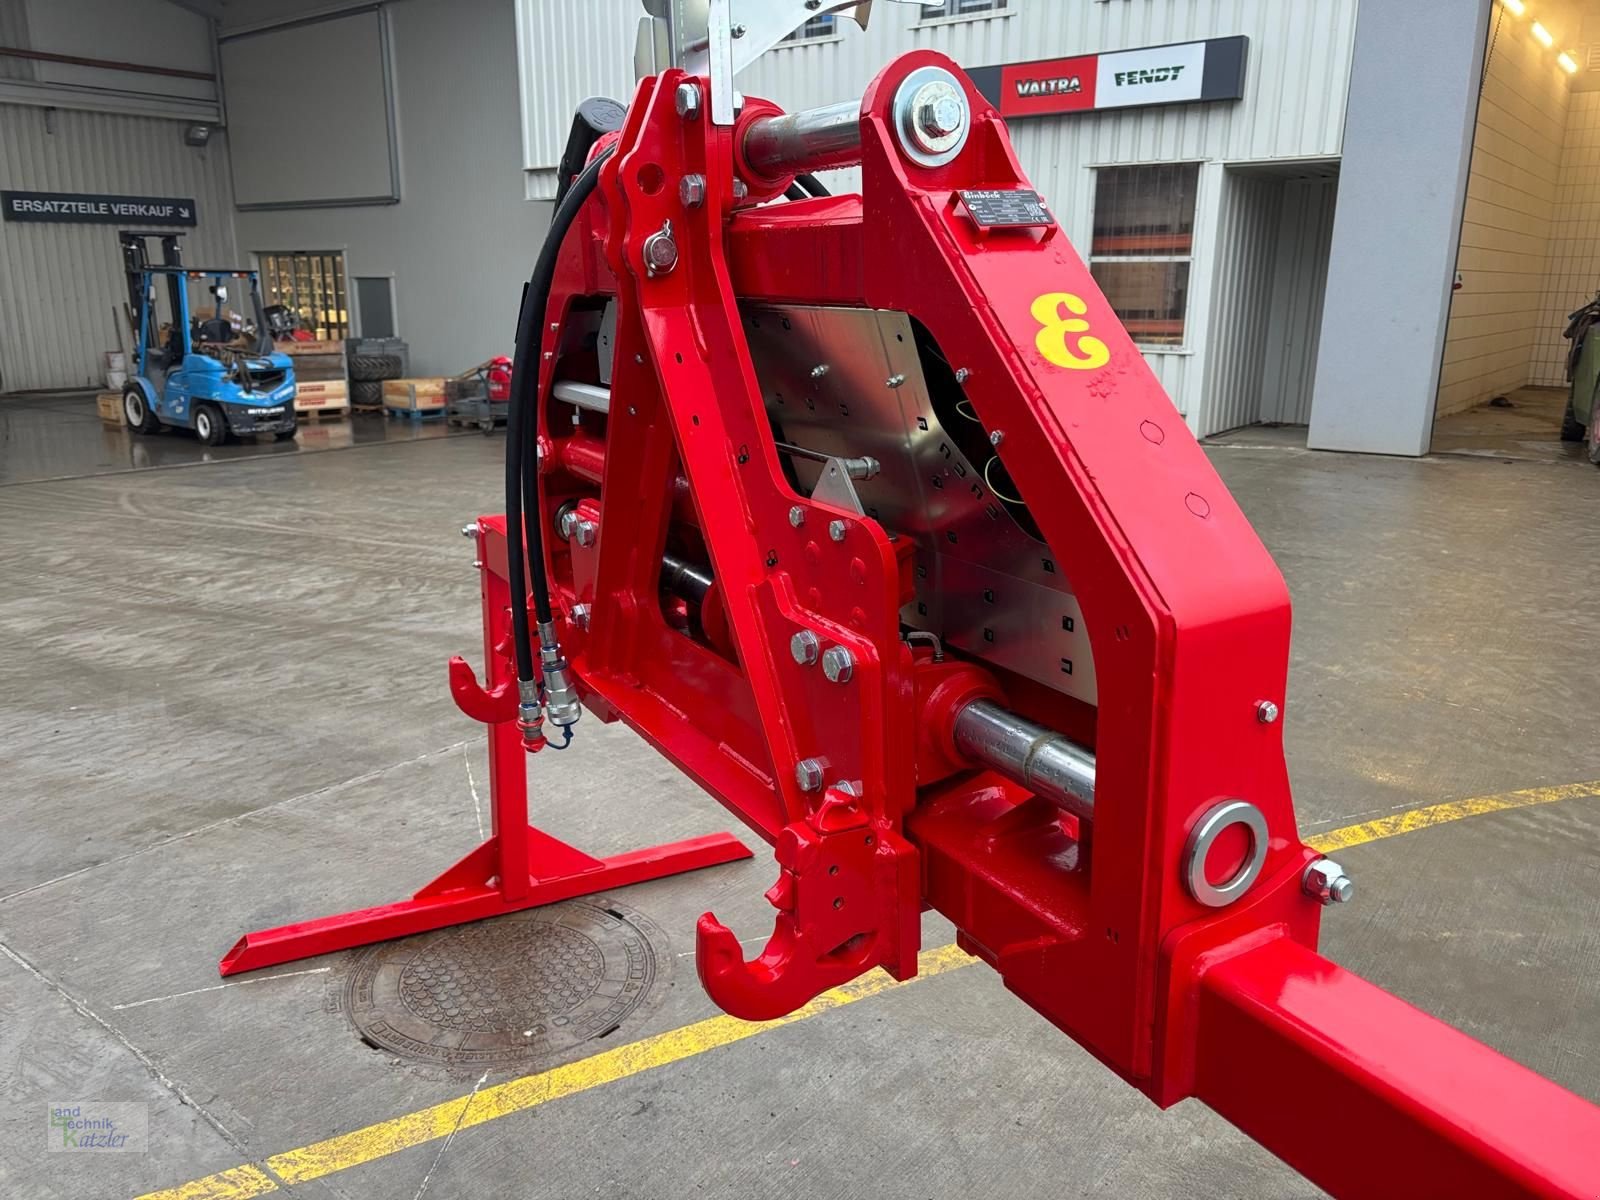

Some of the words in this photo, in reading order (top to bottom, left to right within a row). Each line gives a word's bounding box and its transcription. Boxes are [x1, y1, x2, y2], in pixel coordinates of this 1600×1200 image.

[1114, 65, 1185, 87] FENDT
[1016, 76, 1082, 97] VALTRA
[12, 199, 109, 214] ERSATZTEILE
[111, 203, 174, 217] VERKAUF
[247, 406, 286, 415] MITSUB
